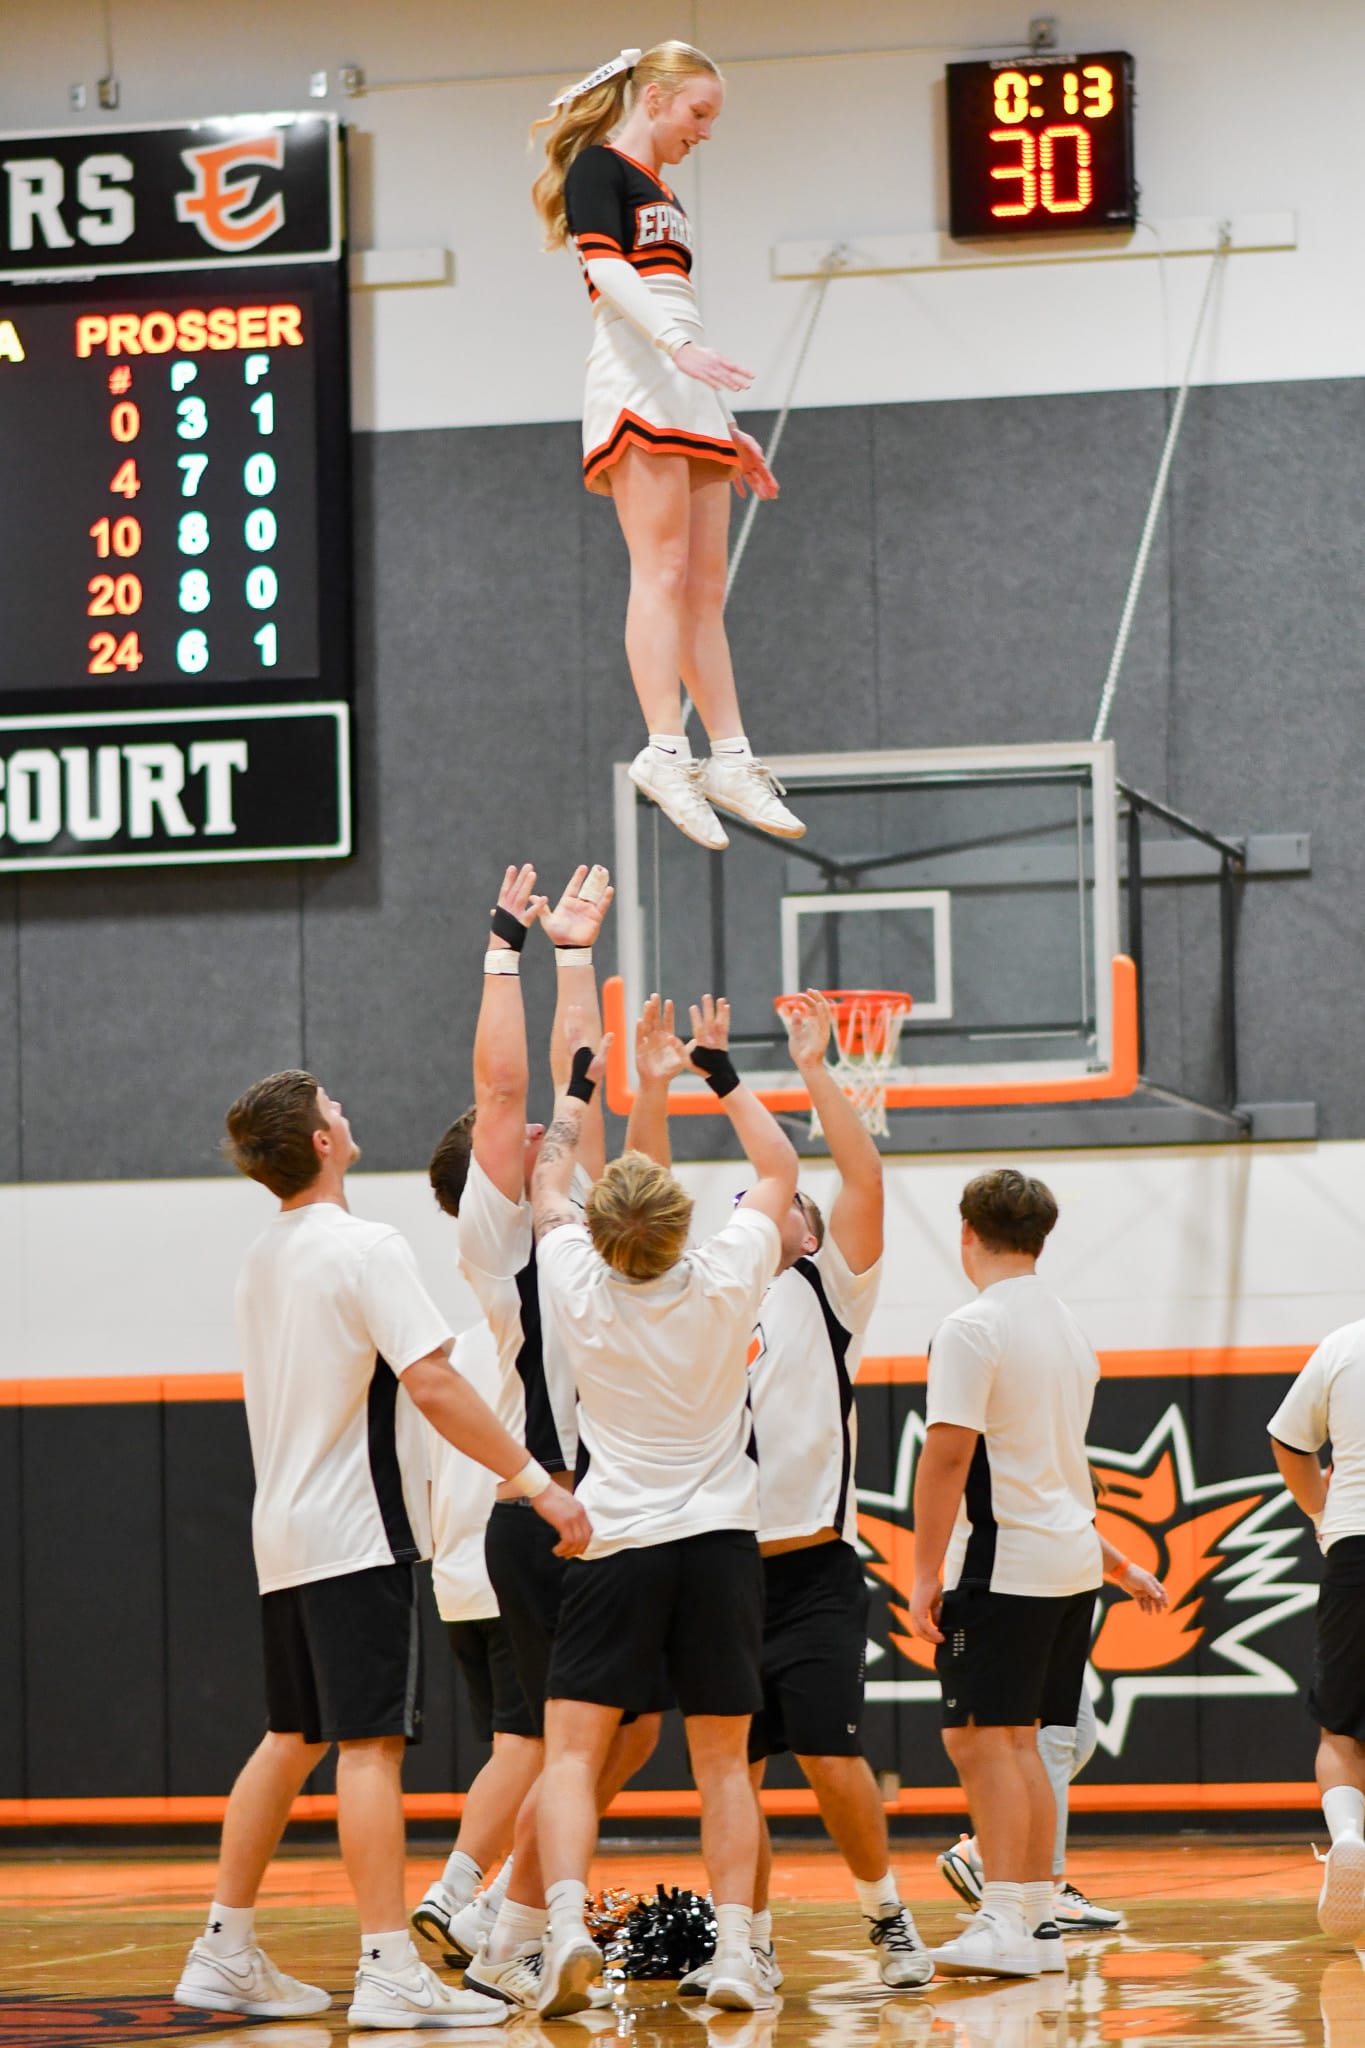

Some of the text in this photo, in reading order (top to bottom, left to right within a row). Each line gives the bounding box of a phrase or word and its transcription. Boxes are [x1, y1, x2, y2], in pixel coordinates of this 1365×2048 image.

[993, 66, 1113, 124] 0:13
[989, 125, 1093, 217] 30
[2, 154, 135, 250] RS
[76, 304, 303, 358] PROSSER
[171, 360, 198, 391] P
[245, 355, 269, 385] F
[110, 392, 273, 442] 0 3 1
[110, 453, 276, 498] 4 7 0
[90, 508, 276, 557] 10 8 0
[87, 566, 277, 616] 20 8 0
[88, 623, 276, 674] 24 6 1
[0, 740, 248, 843] OURT
